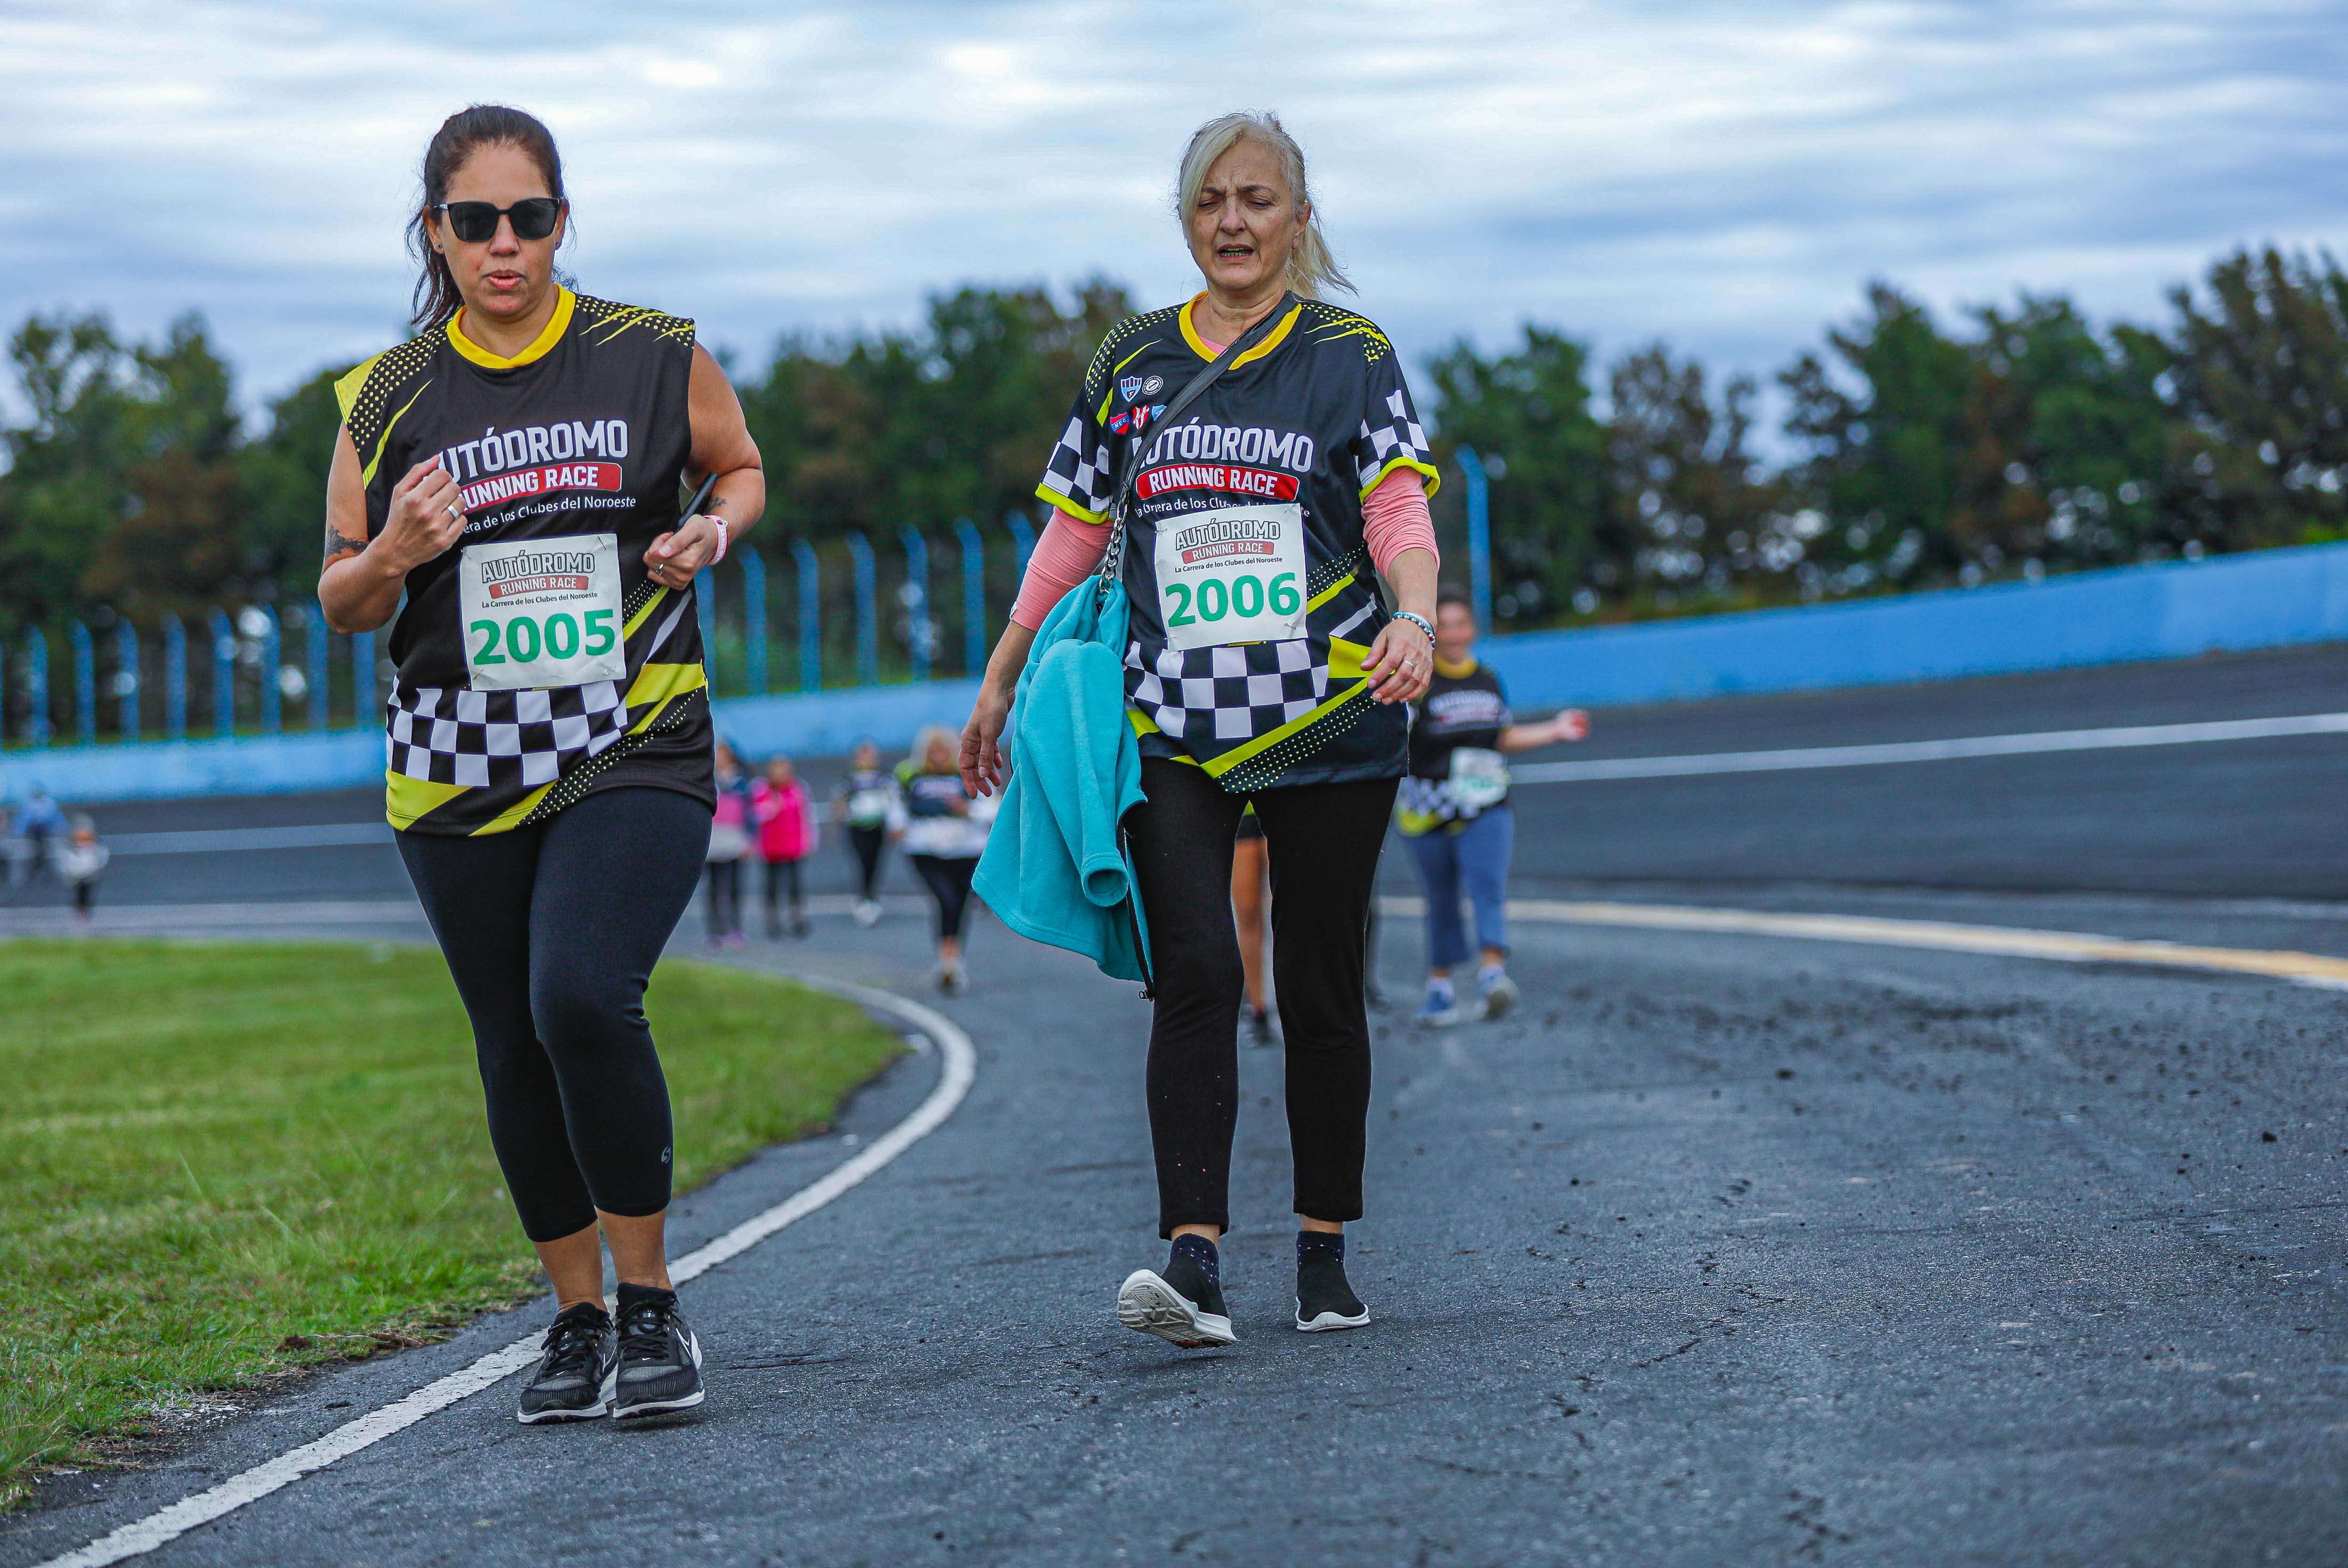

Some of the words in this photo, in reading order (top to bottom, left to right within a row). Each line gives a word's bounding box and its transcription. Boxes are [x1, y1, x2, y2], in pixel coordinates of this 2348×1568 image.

[1115, 418, 1126, 429] NEC
[423, 420, 628, 484] UTÓDROMO
[459, 472, 539, 511] UNNING
[545, 466, 599, 488] RACE
[1148, 466, 1225, 493] RUNNING
[1230, 469, 1278, 495] RACE
[484, 516, 498, 528] de
[500, 510, 515, 523] los
[518, 502, 558, 518] Clubes
[561, 497, 580, 509] del
[585, 496, 636, 508] Noroeste
[1174, 499, 1188, 510] de
[1190, 498, 1206, 509] los
[1175, 518, 1281, 550] AUTÓDROMO
[481, 550, 596, 583] AUTÓDROMO
[1192, 543, 1235, 560] RUNNING
[1238, 542, 1263, 553] RACE
[500, 578, 546, 596] RUNNING
[550, 577, 577, 589] RACE
[1165, 572, 1301, 628] 2006
[470, 609, 616, 665] 2005
